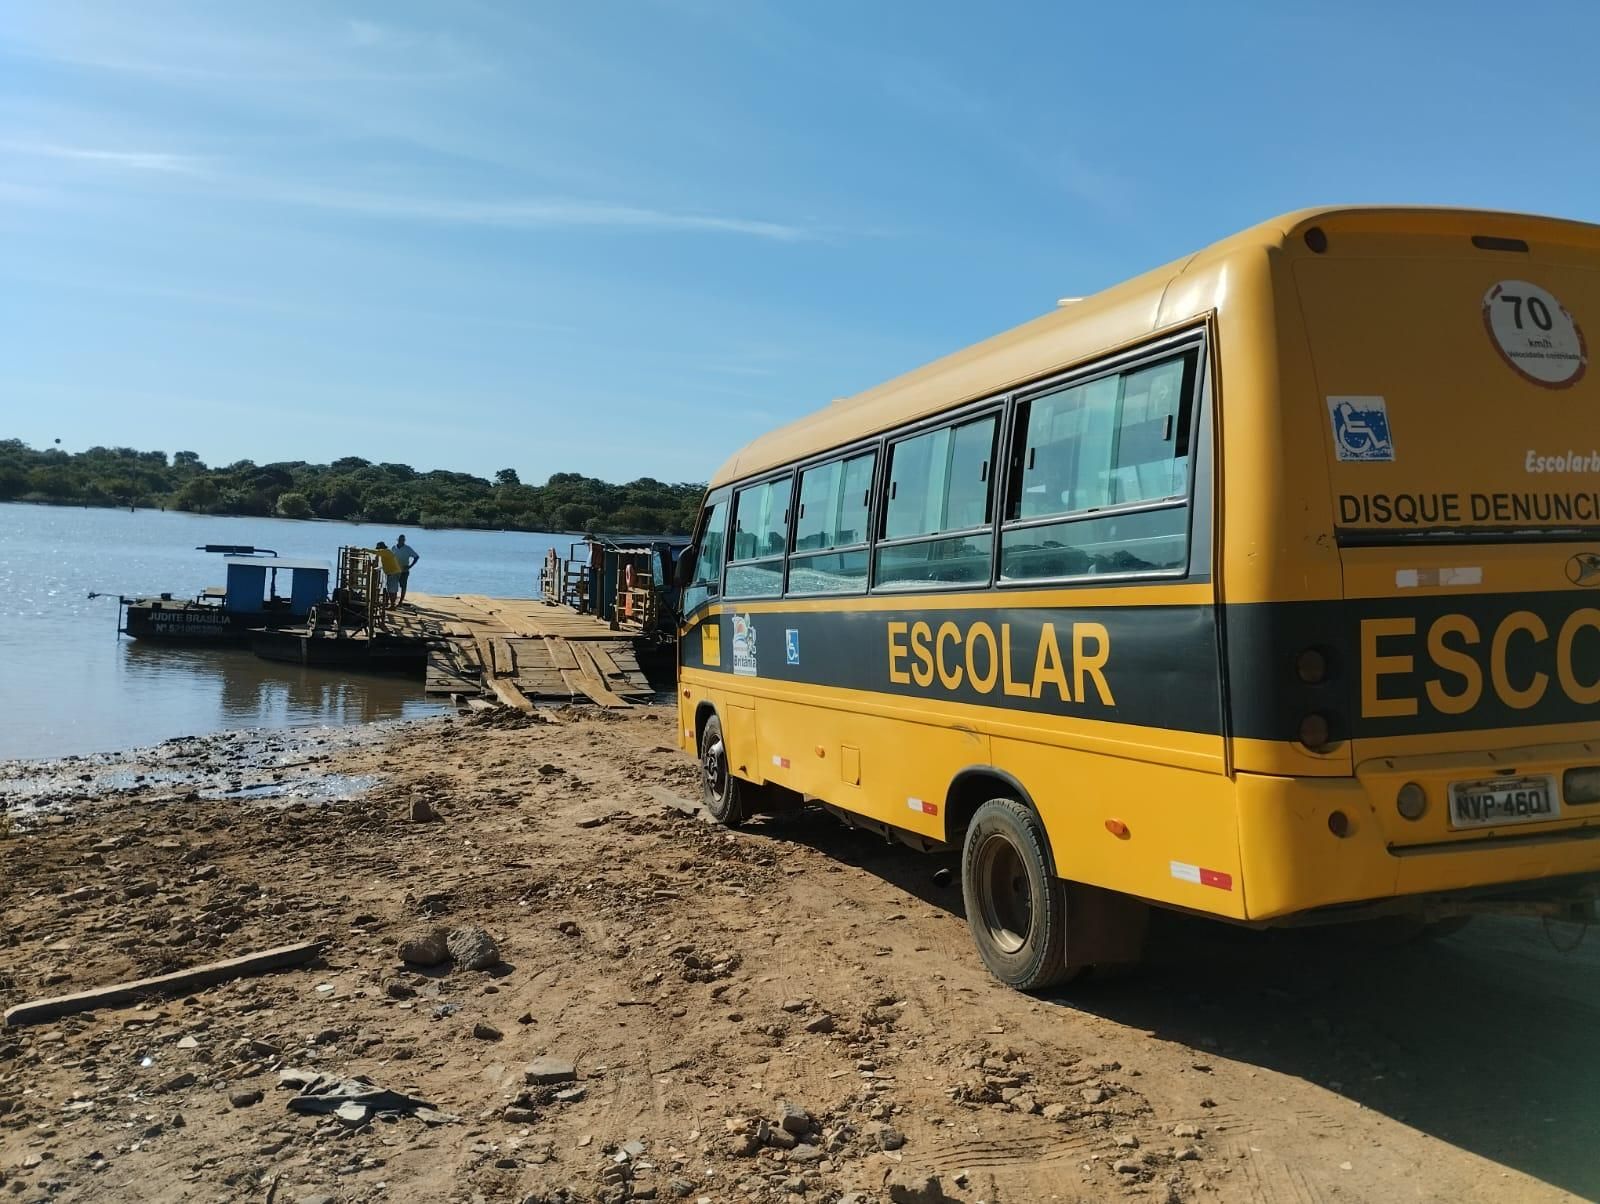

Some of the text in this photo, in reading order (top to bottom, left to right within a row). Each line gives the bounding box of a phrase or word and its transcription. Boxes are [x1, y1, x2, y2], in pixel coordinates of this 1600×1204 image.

[1500, 295, 1553, 331] 70
[1528, 338, 1552, 348] km/h
[1339, 493, 1600, 524] DISQUE DENUNCI
[148, 612, 183, 622] JUDITE
[887, 621, 1116, 706] ESCOLAR
[1360, 607, 1600, 718] ESCO
